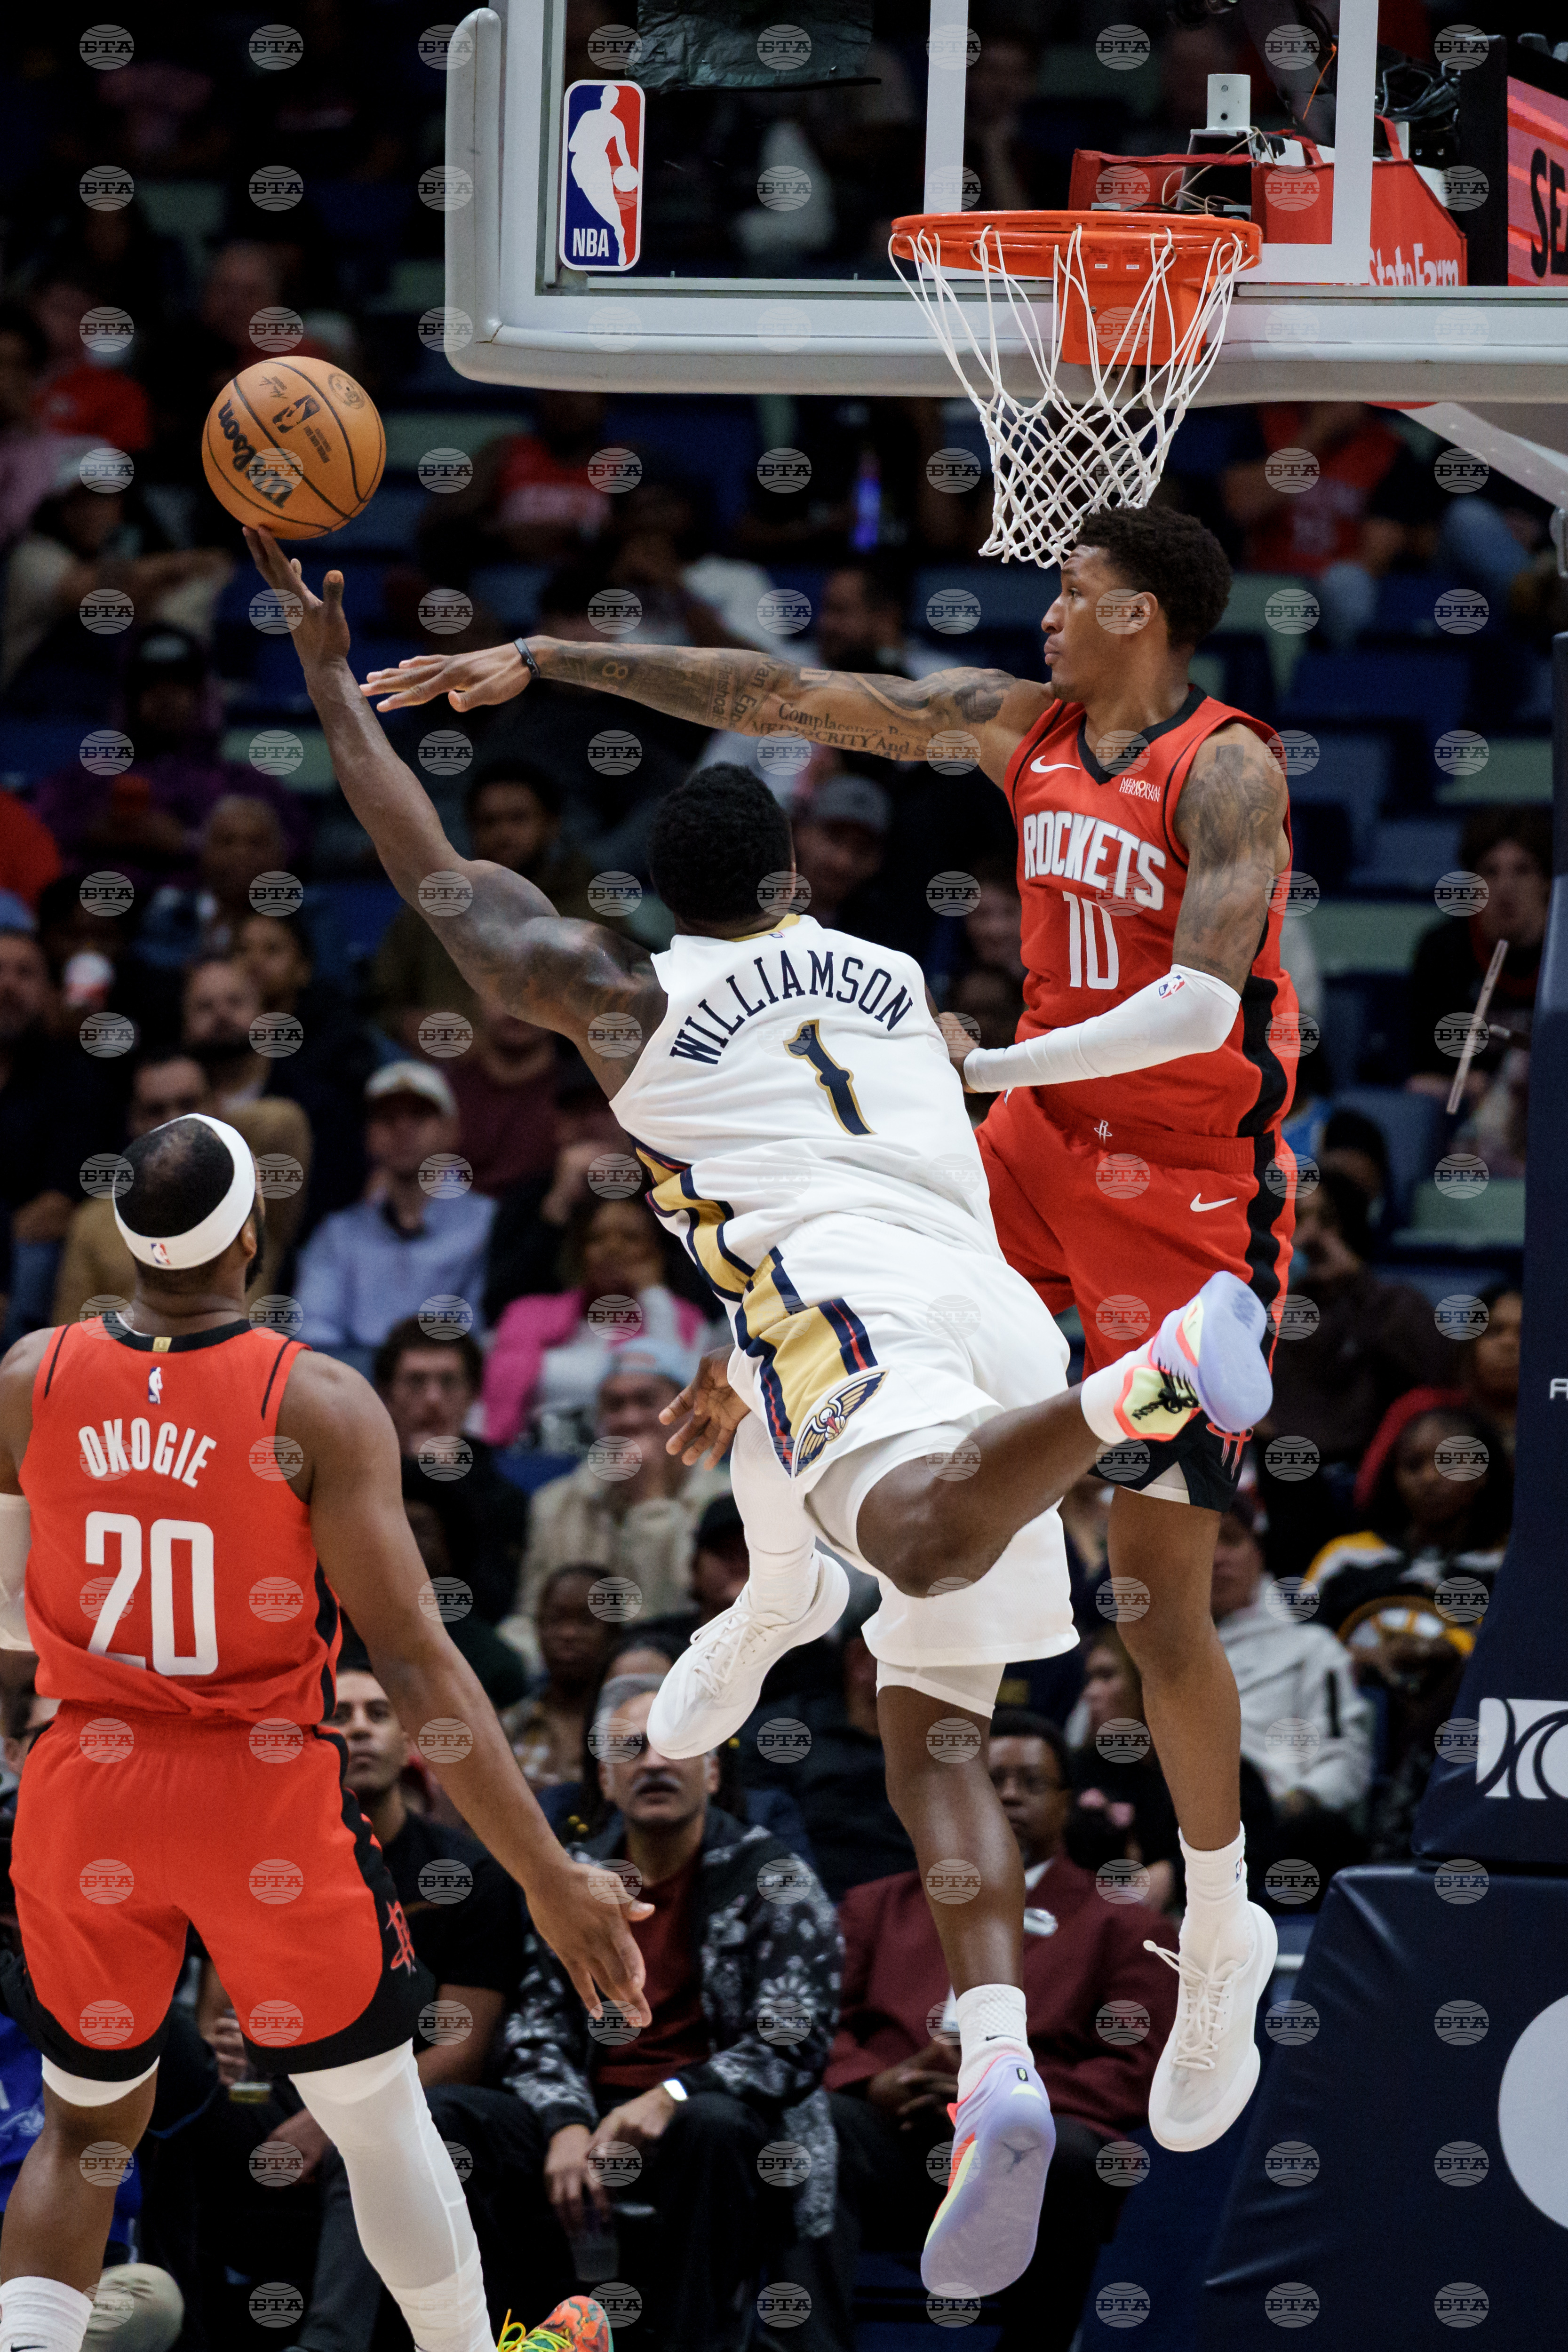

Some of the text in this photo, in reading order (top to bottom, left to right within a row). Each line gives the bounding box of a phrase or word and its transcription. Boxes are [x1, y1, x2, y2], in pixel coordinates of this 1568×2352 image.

[573, 228, 609, 257] NBA
[1413, 243, 1458, 286] Farm
[1119, 783, 1161, 803] HERMANN
[1121, 777, 1161, 795] MEMORIAL
[1023, 810, 1166, 911] ROCKETS
[1063, 891, 1119, 990] 10
[669, 949, 914, 1065] WILLIAMSON
[782, 1019, 878, 1137] 1
[78, 1417, 217, 1488] OKOGIE
[85, 1510, 219, 1676] 20
